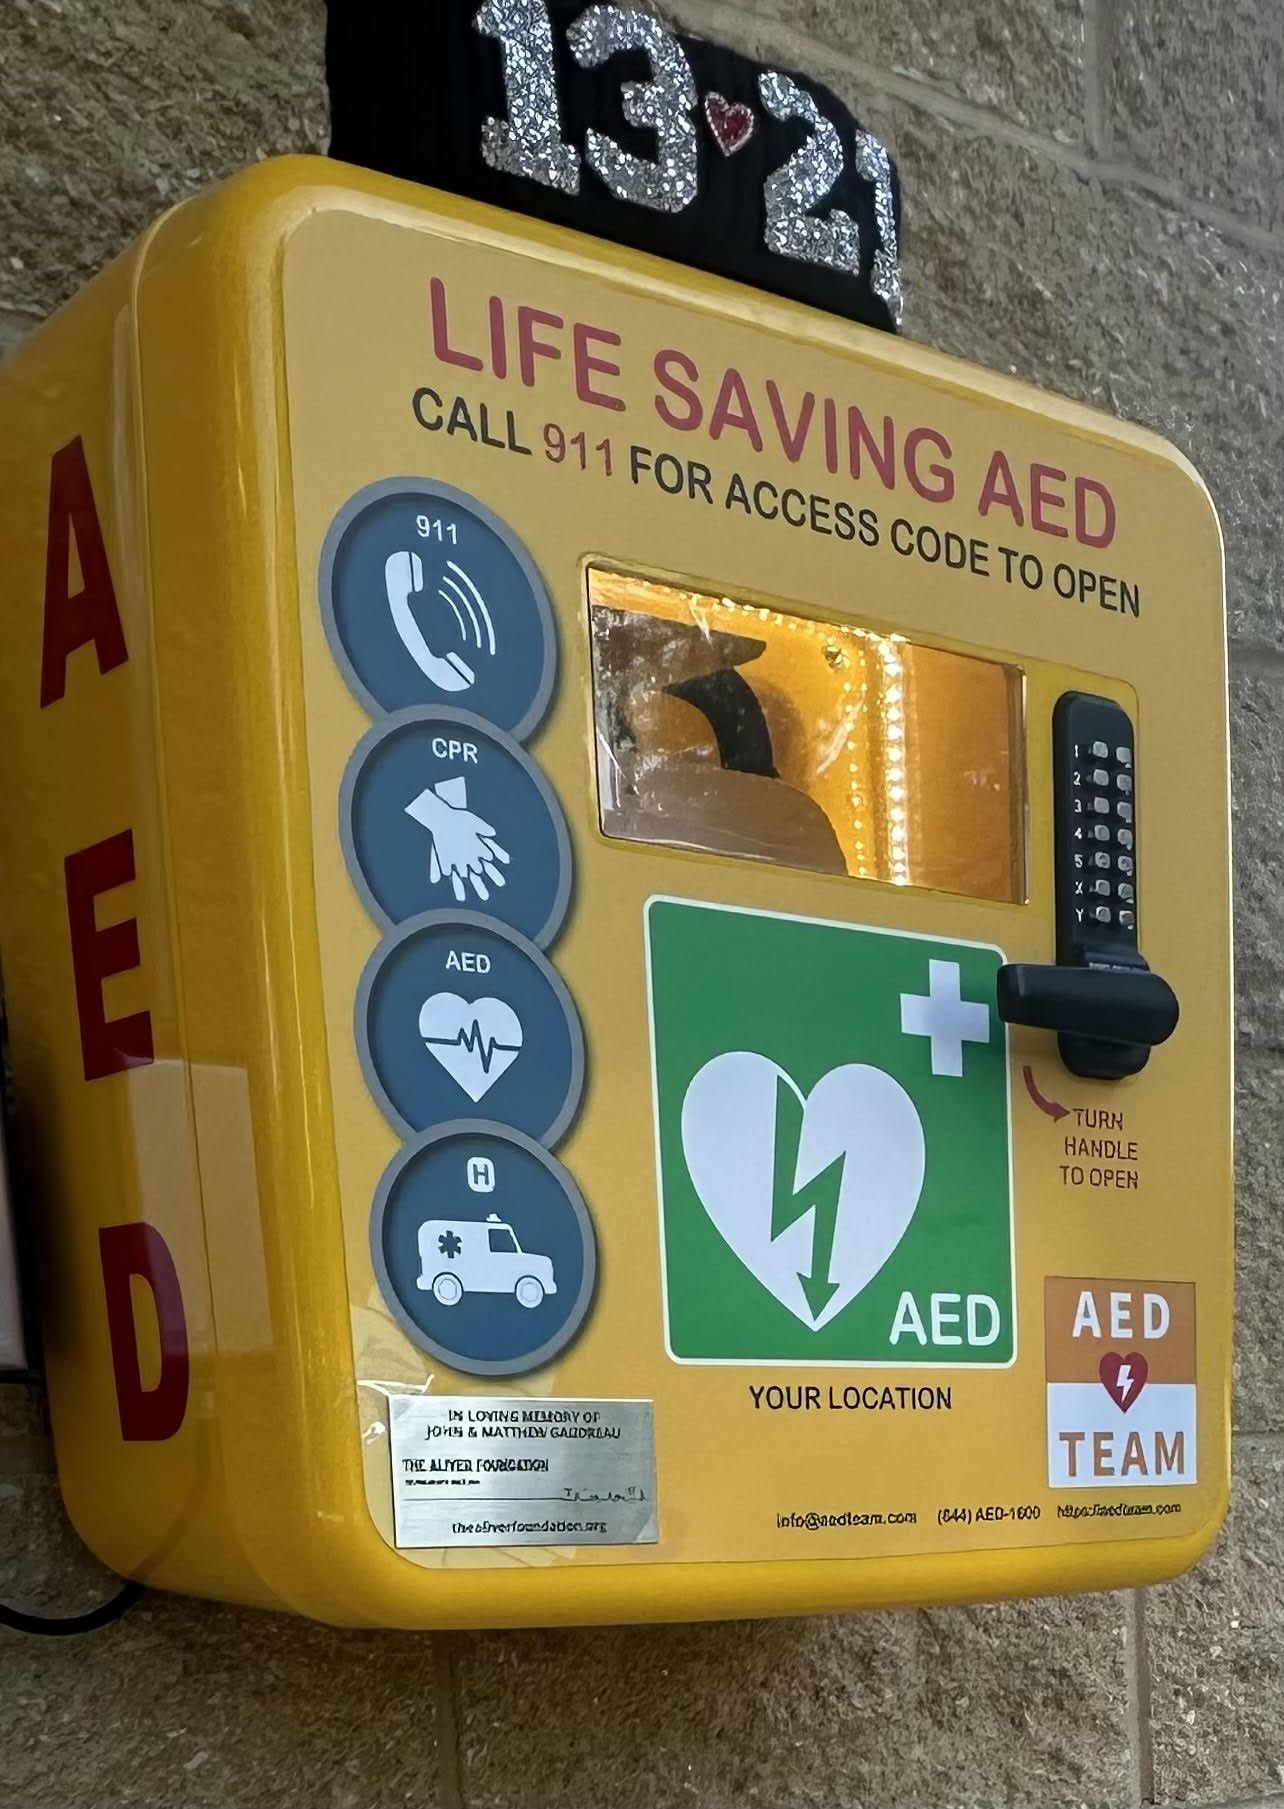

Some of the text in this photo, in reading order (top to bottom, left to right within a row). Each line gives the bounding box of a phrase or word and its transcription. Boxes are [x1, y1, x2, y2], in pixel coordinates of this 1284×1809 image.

[471, 0, 904, 326] 13 21
[430, 277, 1117, 549] LIFE SAVING AED
[411, 387, 1141, 618] CALL 911 FOR ACCESS CODE TO OPEN
[416, 514, 459, 546] 911
[431, 737, 479, 764] CPR
[1074, 744, 1079, 759] 1
[1073, 771, 1081, 786] 2
[1074, 799, 1082, 813] 3
[1074, 827, 1082, 840] 4
[1074, 854, 1083, 868] 5
[1075, 881, 1083, 895] X
[1075, 908, 1084, 922] Y
[445, 950, 491, 974] AED
[1072, 1108, 1123, 1131] TURN
[1064, 1136, 1138, 1160] HANDLE
[1059, 1166, 1139, 1190] TO OPEN
[889, 1291, 1001, 1346] AED
[1072, 1291, 1171, 1339] AED
[750, 1386, 953, 1410] YOUR LOCATION
[468, 1410, 519, 1422] LOVING
[522, 1410, 580, 1423] MEMORY
[402, 1459, 427, 1472] THE
[1059, 1431, 1185, 1477] TEAM
